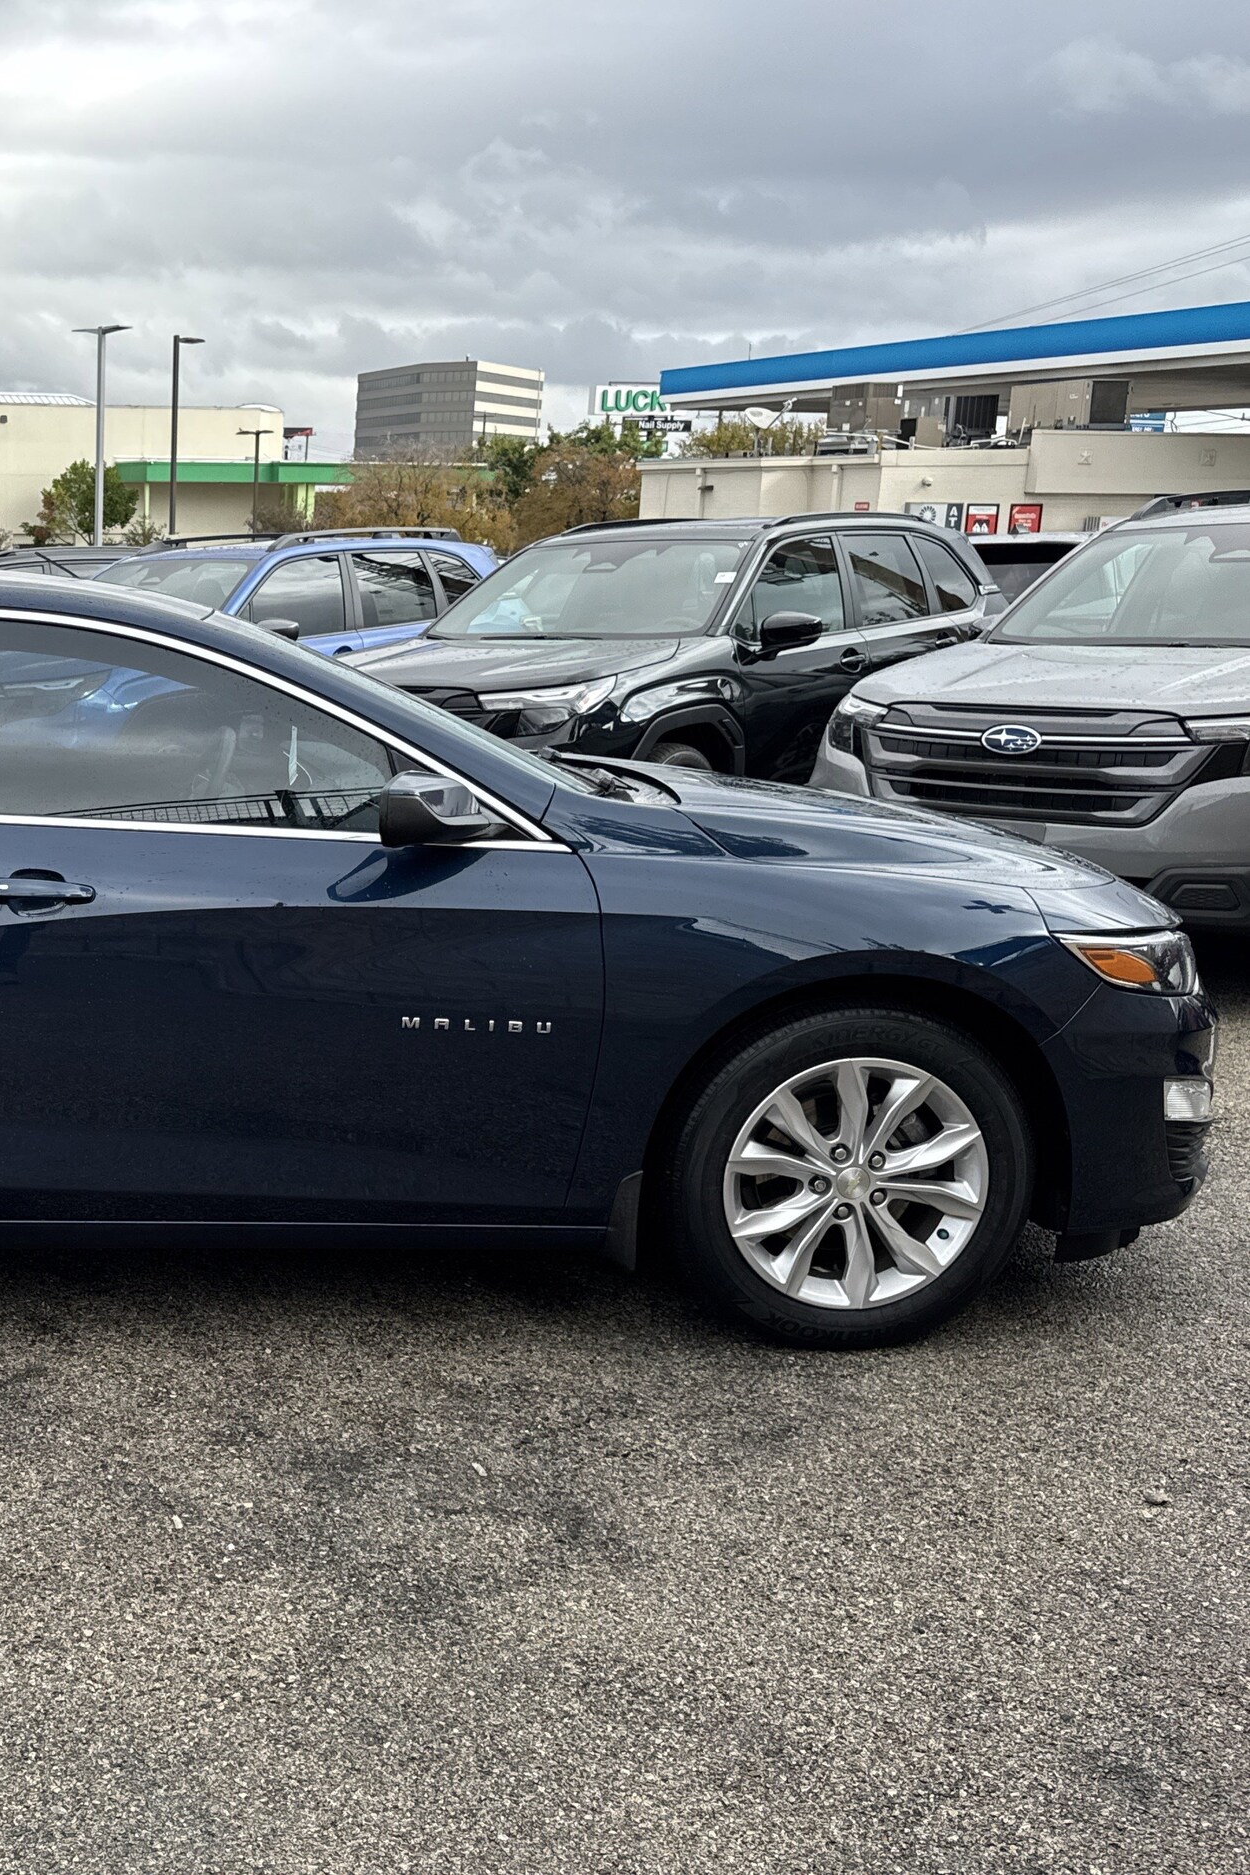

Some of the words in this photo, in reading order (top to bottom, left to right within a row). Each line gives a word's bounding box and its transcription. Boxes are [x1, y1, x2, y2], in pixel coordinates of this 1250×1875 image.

[638, 420, 655, 429] Nail
[656, 420, 685, 431] Supply
[948, 505, 958, 530] AT
[401, 1016, 552, 1034] MALIBU
